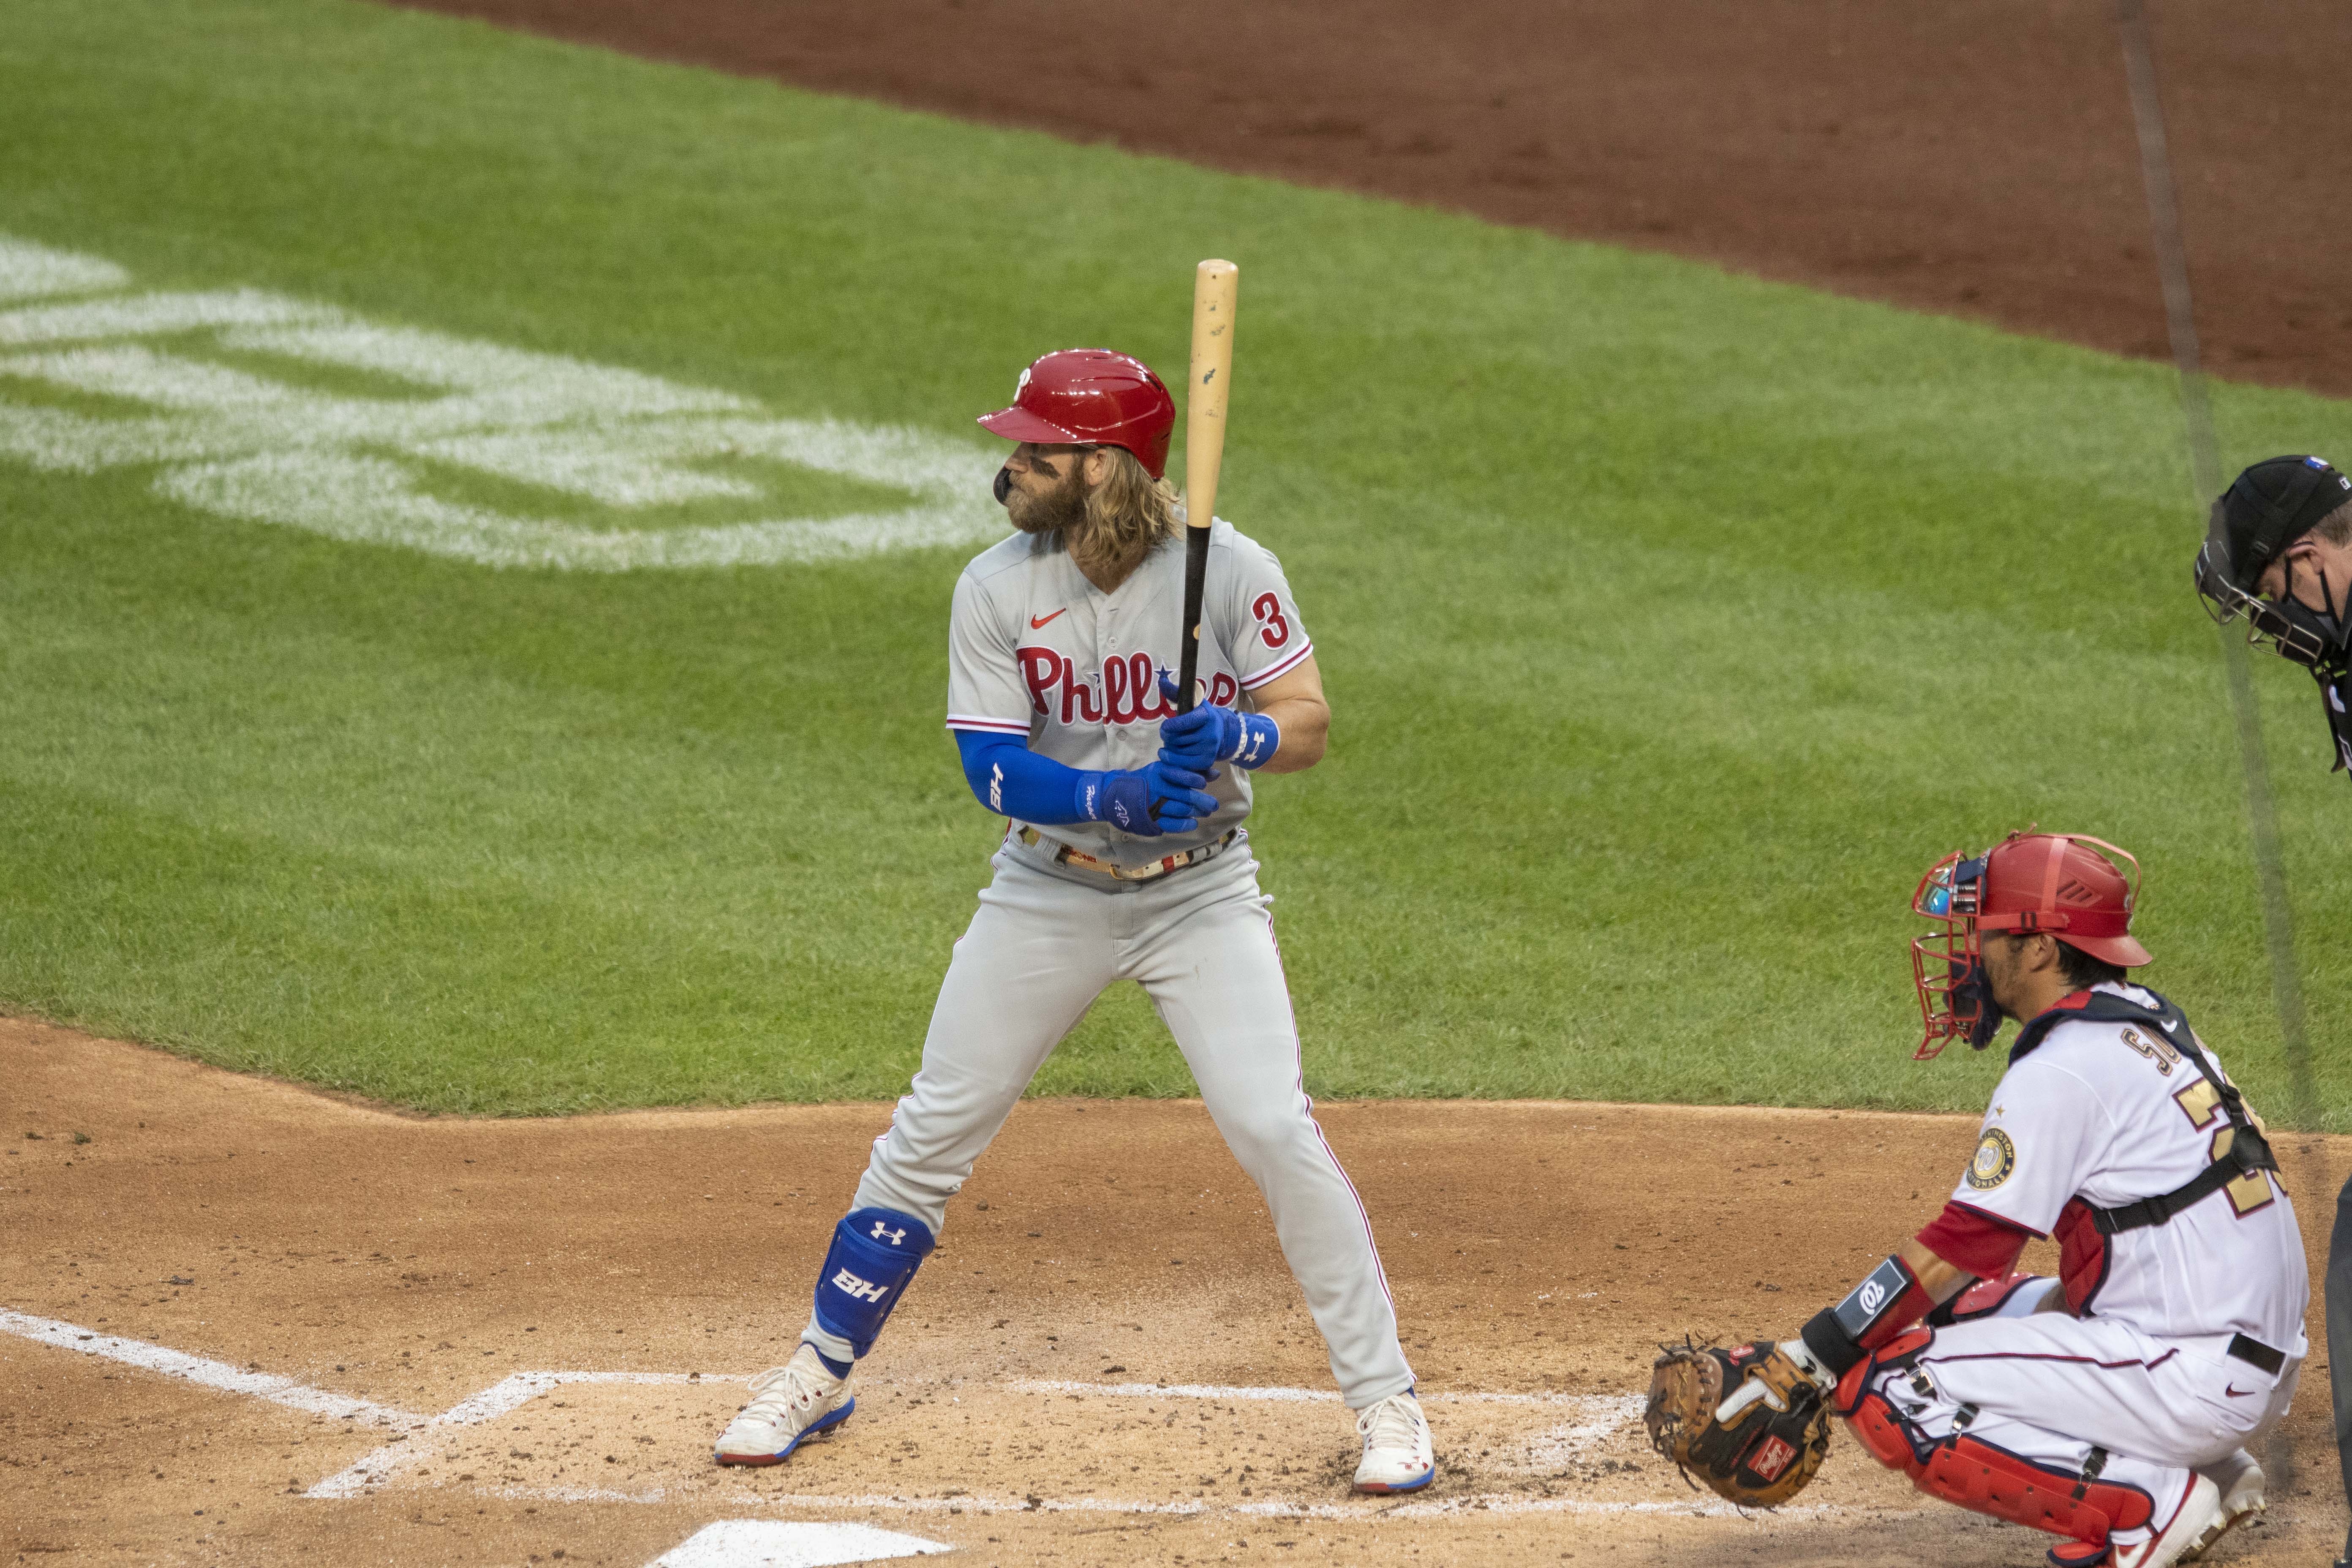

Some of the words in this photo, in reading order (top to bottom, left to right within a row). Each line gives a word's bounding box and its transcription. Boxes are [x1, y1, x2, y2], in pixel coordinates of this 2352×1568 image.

[1251, 591, 1289, 650] 3
[832, 1267, 889, 1304] BH
[1859, 1280, 1885, 1315] W
